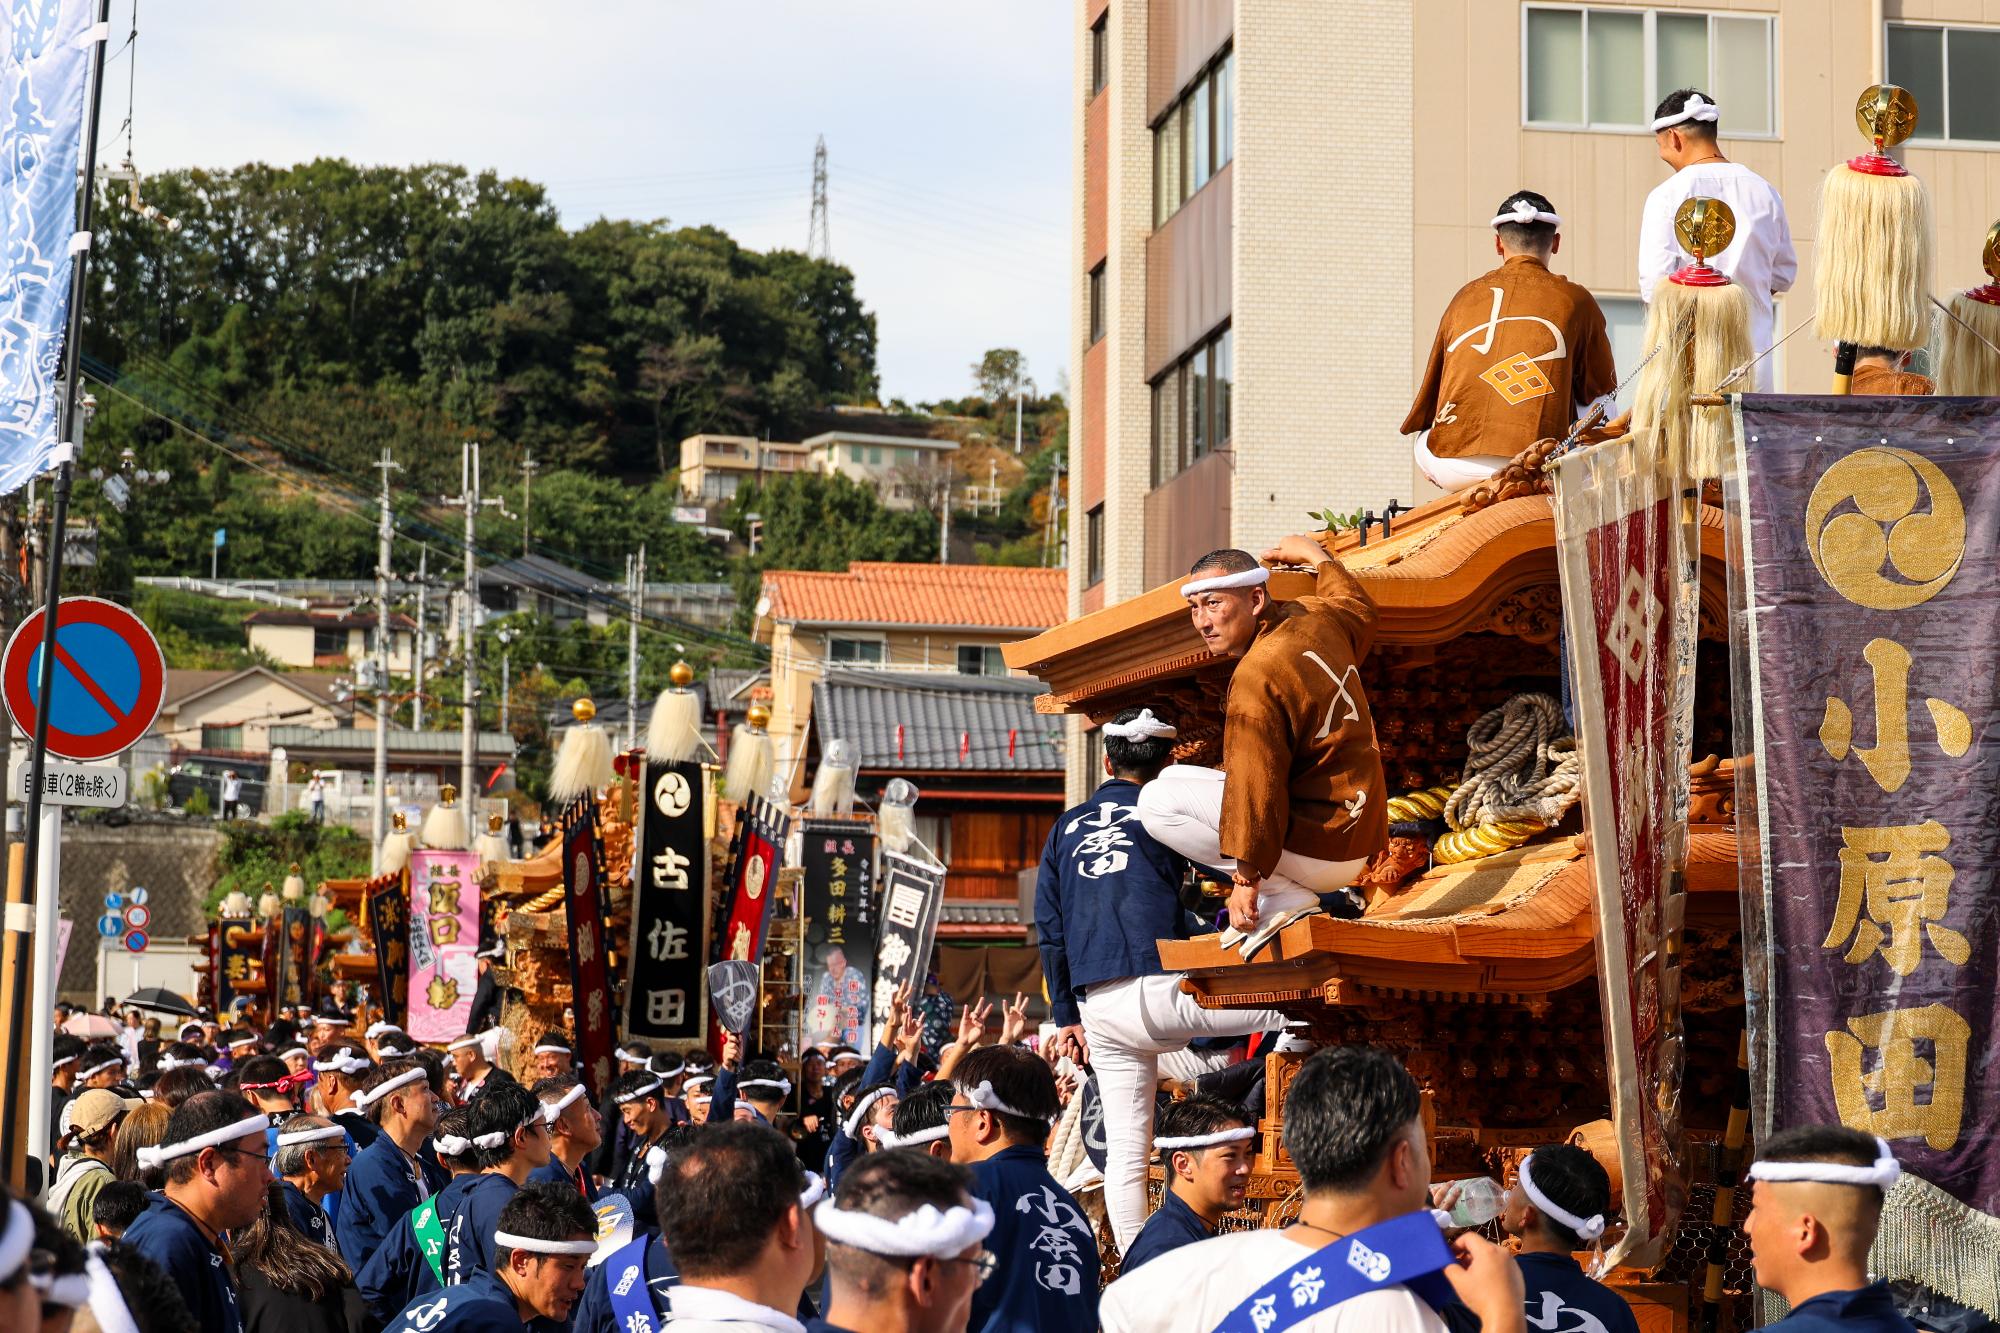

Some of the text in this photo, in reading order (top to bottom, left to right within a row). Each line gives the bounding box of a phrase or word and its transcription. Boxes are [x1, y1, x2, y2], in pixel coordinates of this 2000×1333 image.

[646, 847, 690, 1026] 古佐田
[1819, 638, 1973, 1151] 小原田
